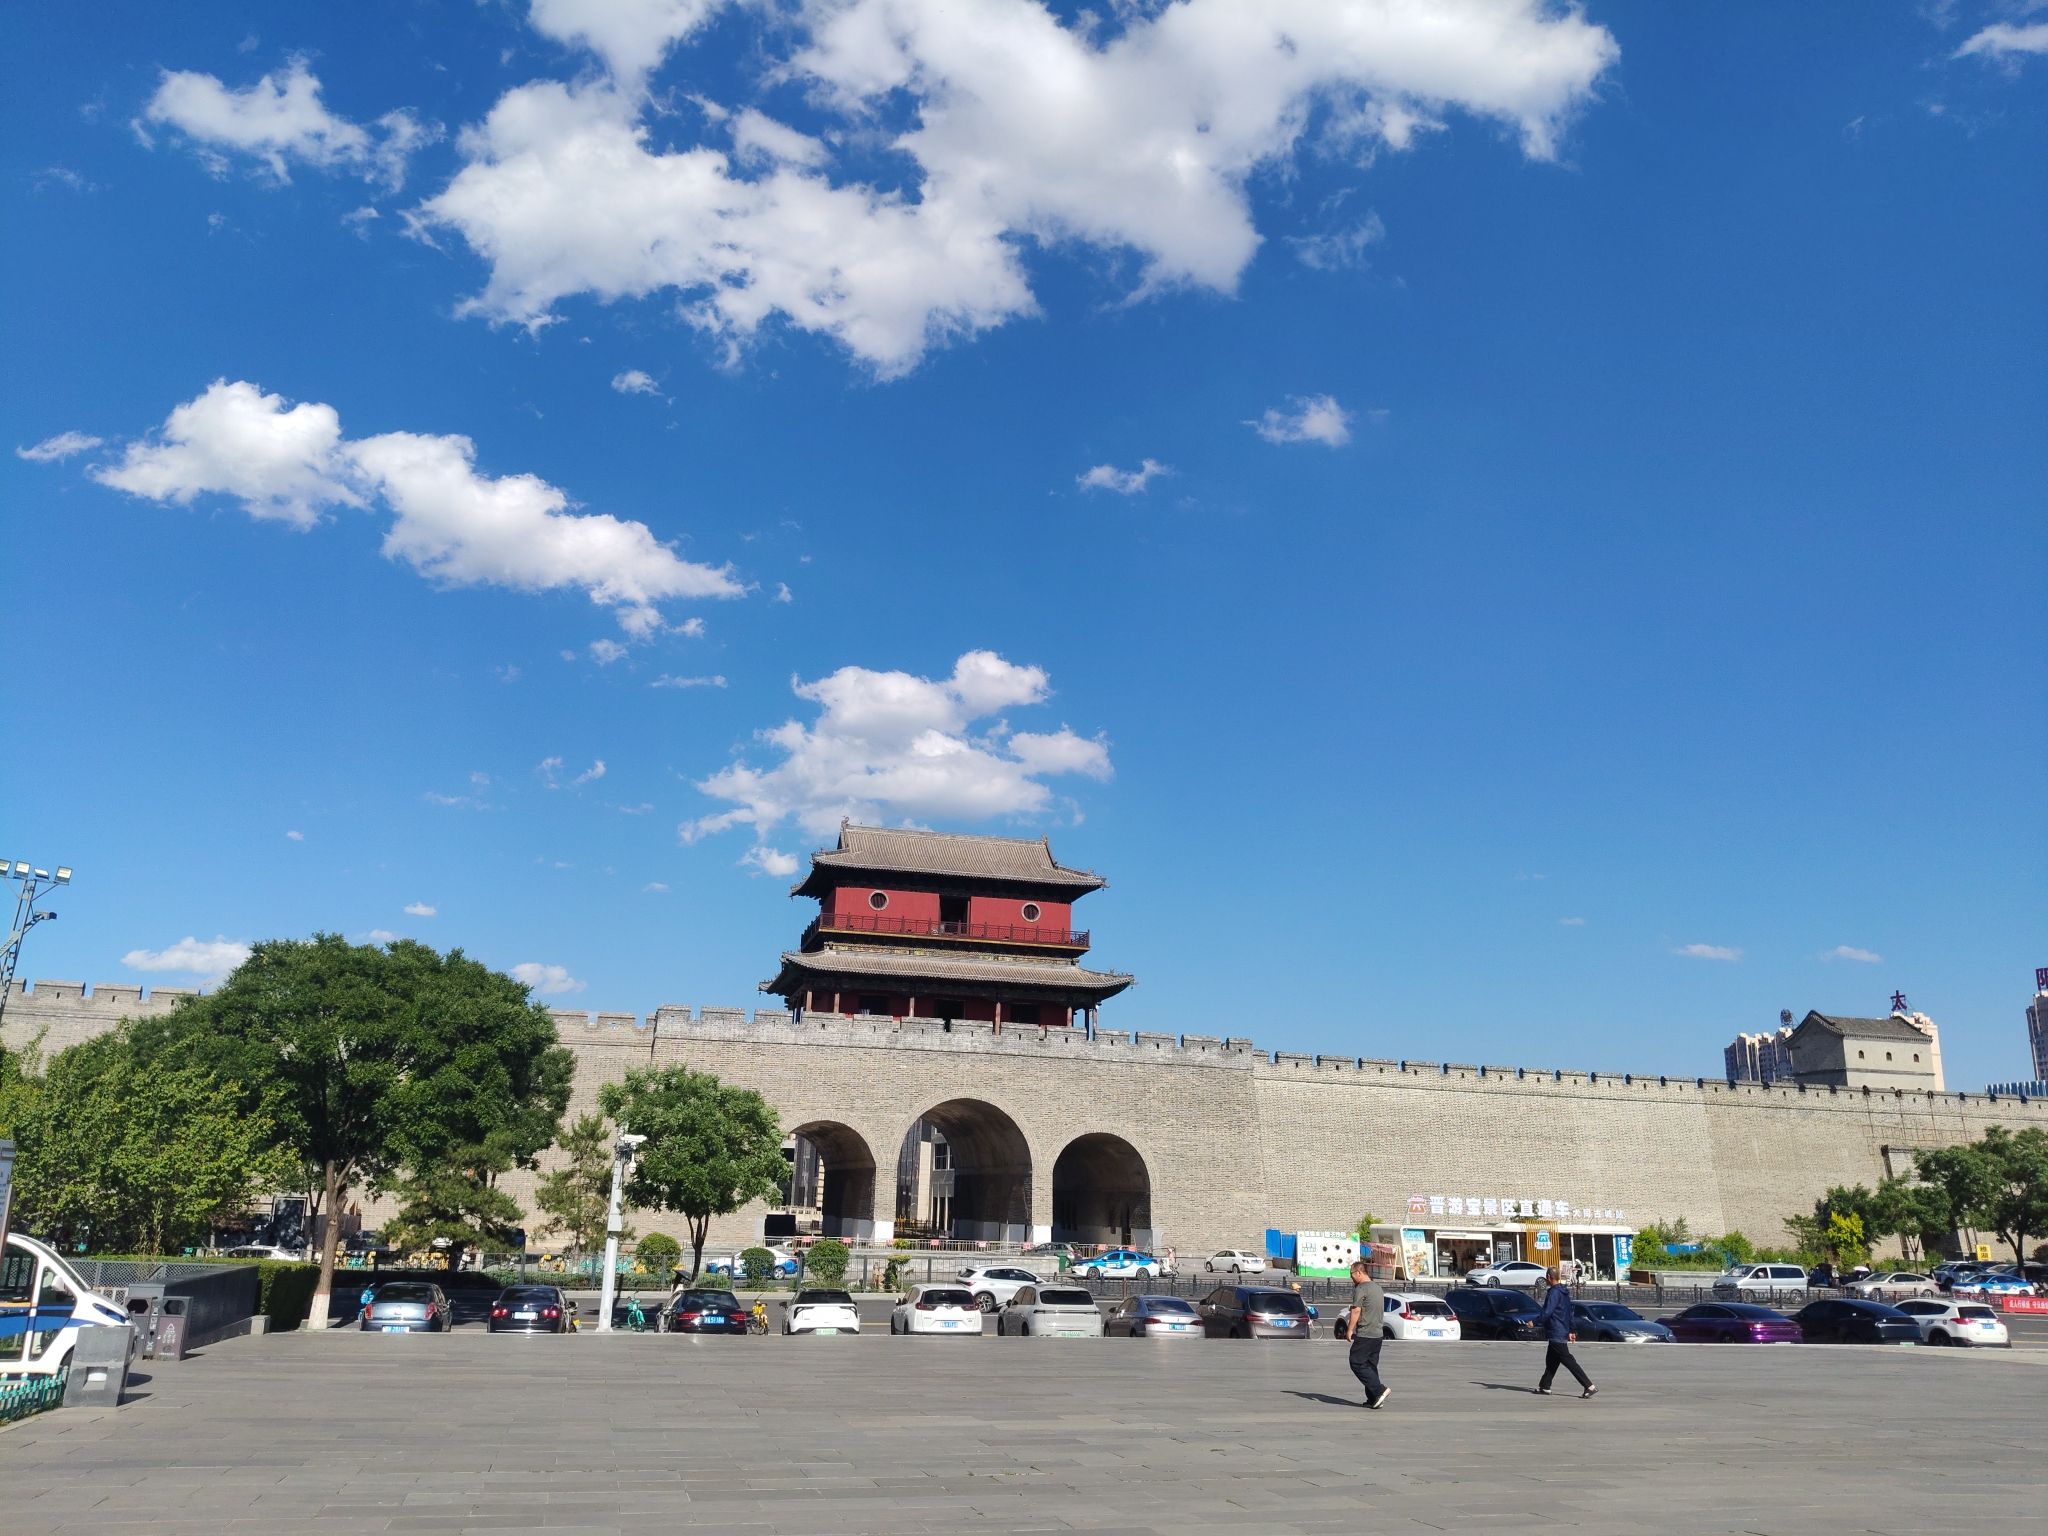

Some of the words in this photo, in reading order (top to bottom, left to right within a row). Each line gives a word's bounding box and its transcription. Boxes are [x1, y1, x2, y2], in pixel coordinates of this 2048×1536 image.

[1429, 1195, 1570, 1217] 晋游宝景区直通车
